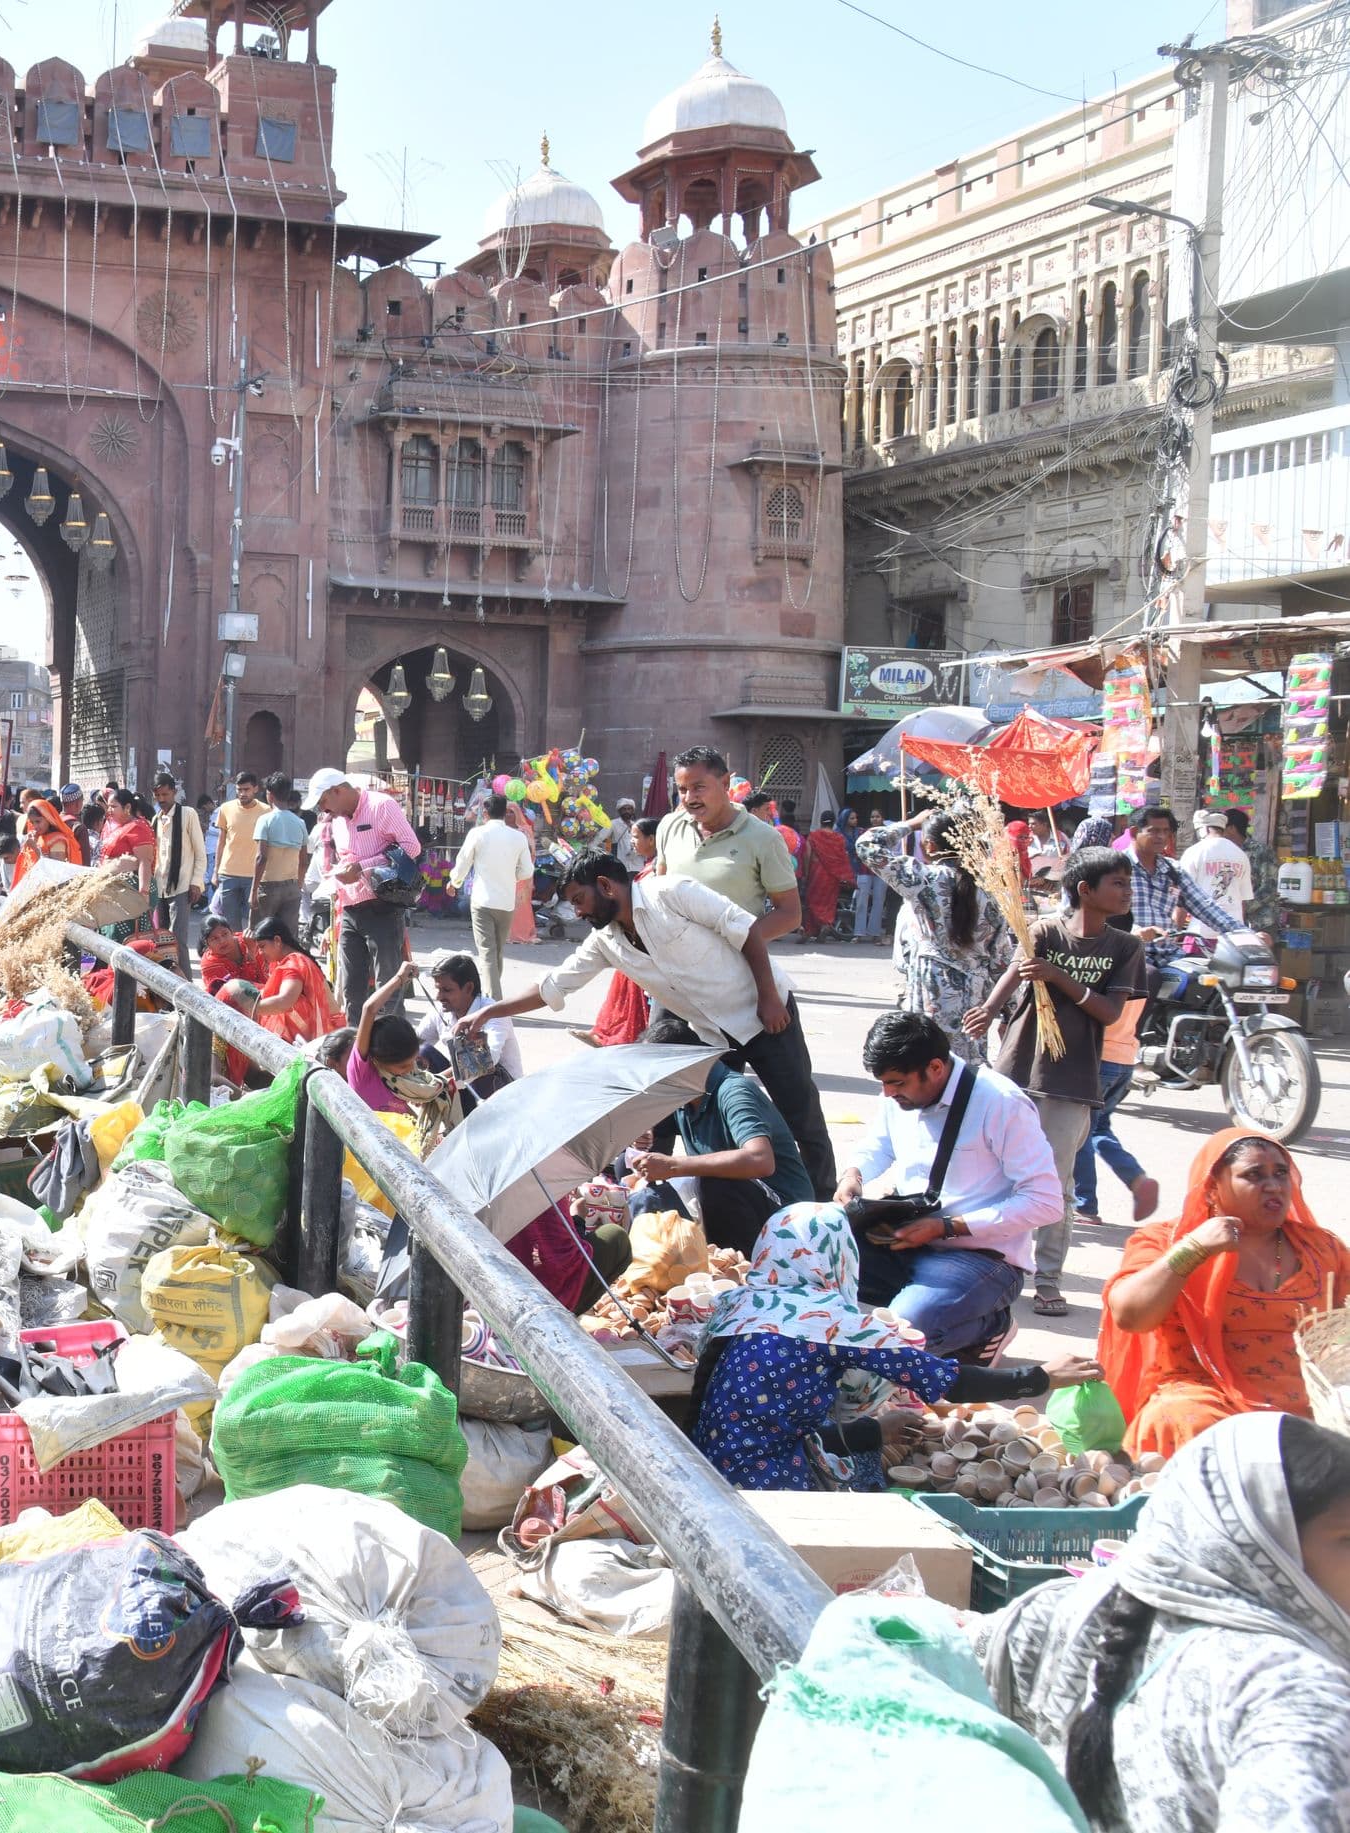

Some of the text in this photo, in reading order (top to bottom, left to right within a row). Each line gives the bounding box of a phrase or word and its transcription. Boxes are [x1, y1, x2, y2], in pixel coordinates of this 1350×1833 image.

[879, 667, 926, 683] MILAN
[896, 694, 922, 702] Flowers
[54, 1655, 84, 1712] RICE
